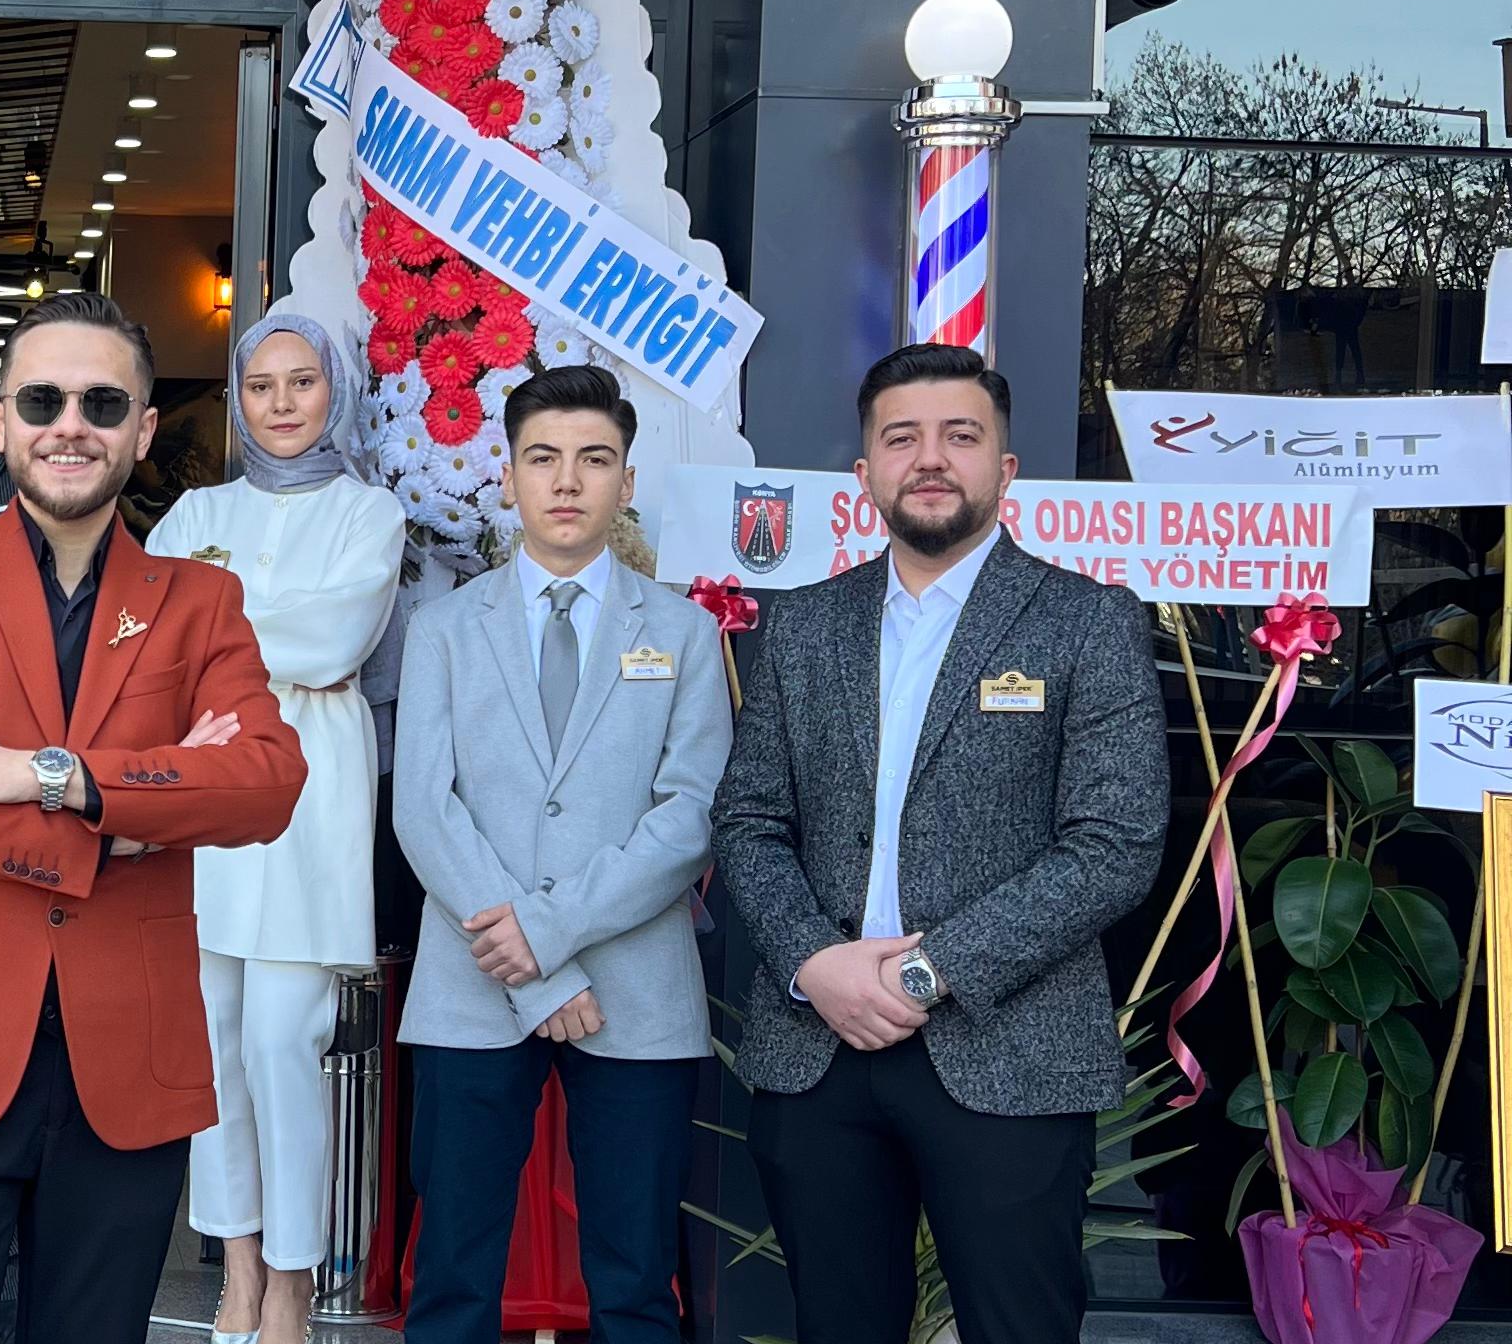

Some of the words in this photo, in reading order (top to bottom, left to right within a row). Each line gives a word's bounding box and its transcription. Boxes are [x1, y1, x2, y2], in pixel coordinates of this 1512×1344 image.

[355, 84, 471, 218] SMMM
[449, 158, 601, 292] VEHBİ
[1034, 498, 1147, 546] ODASI
[1160, 500, 1333, 558] BAŞKANI
[1140, 552, 1329, 591] YÖNETİM
